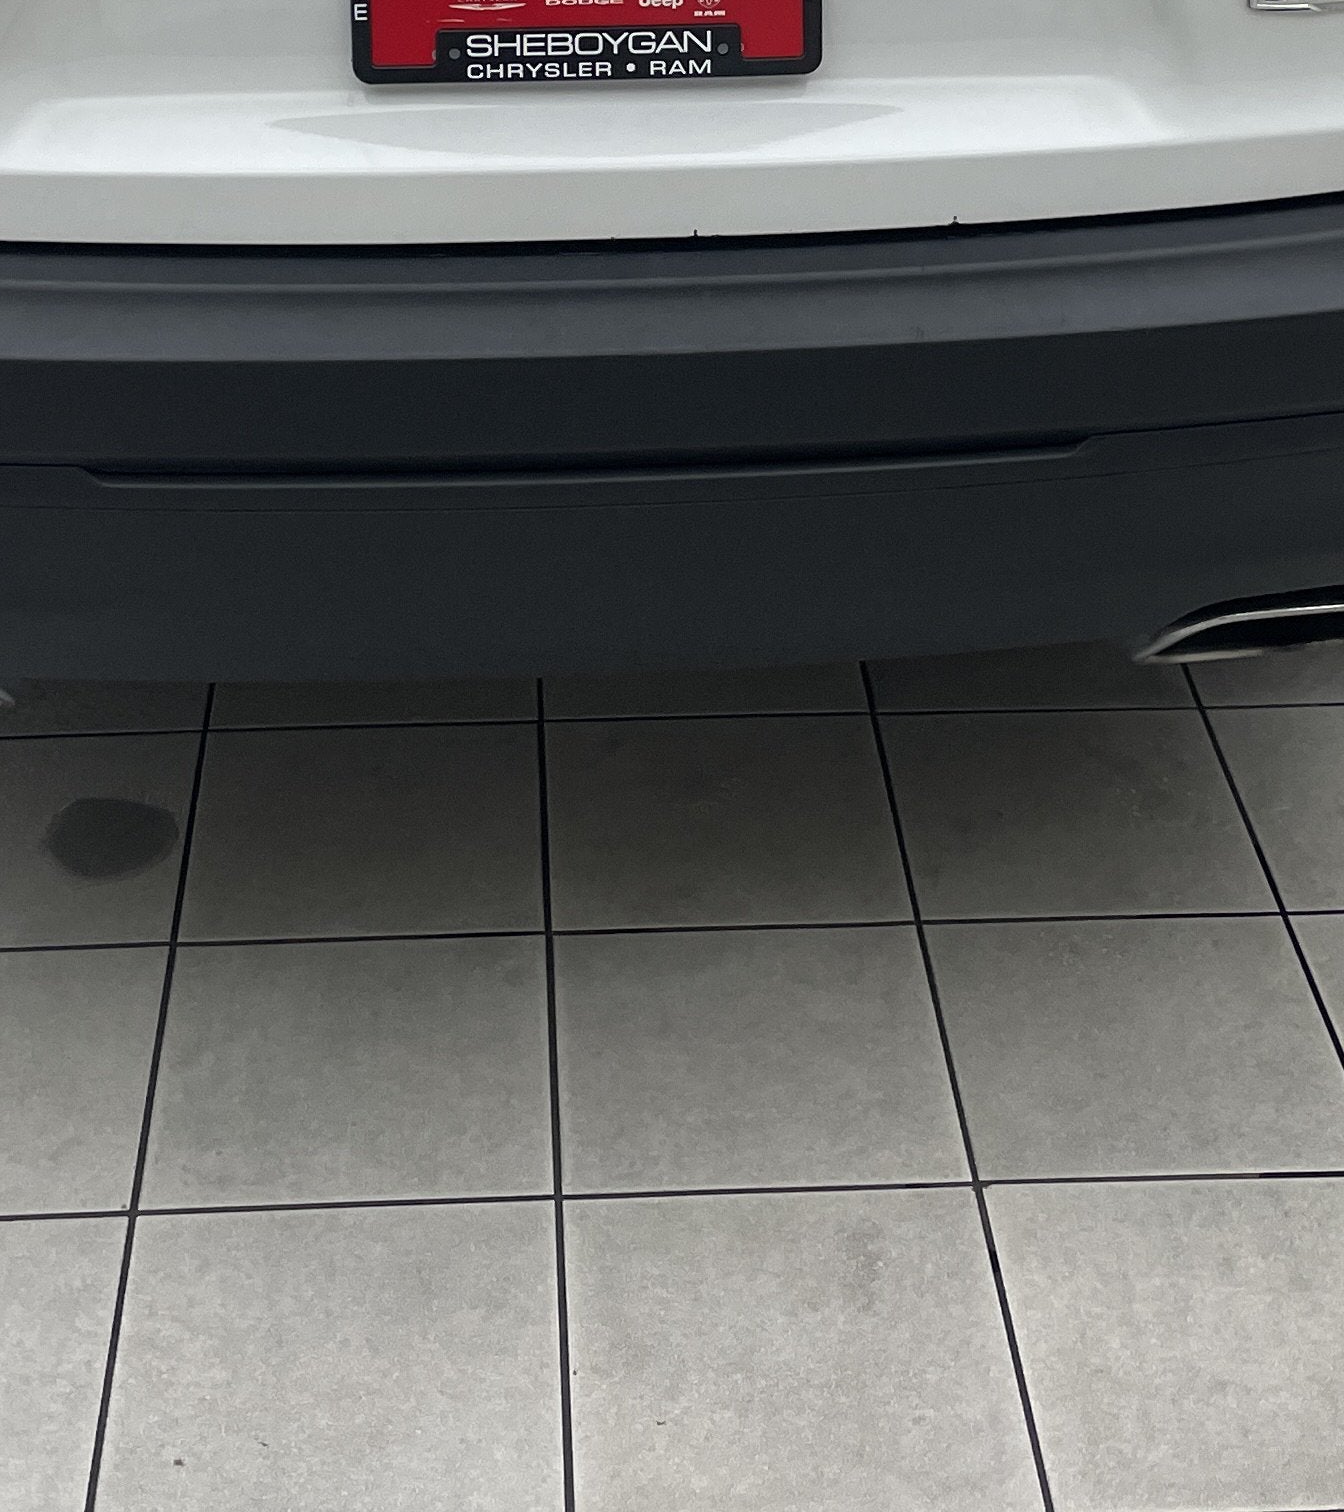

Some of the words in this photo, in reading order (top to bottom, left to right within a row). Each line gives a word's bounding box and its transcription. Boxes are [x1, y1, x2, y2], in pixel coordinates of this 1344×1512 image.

[466, 30, 712, 57] SHEBOYGAN
[467, 62, 613, 79] CHRYSLER
[650, 60, 712, 75] RAM
